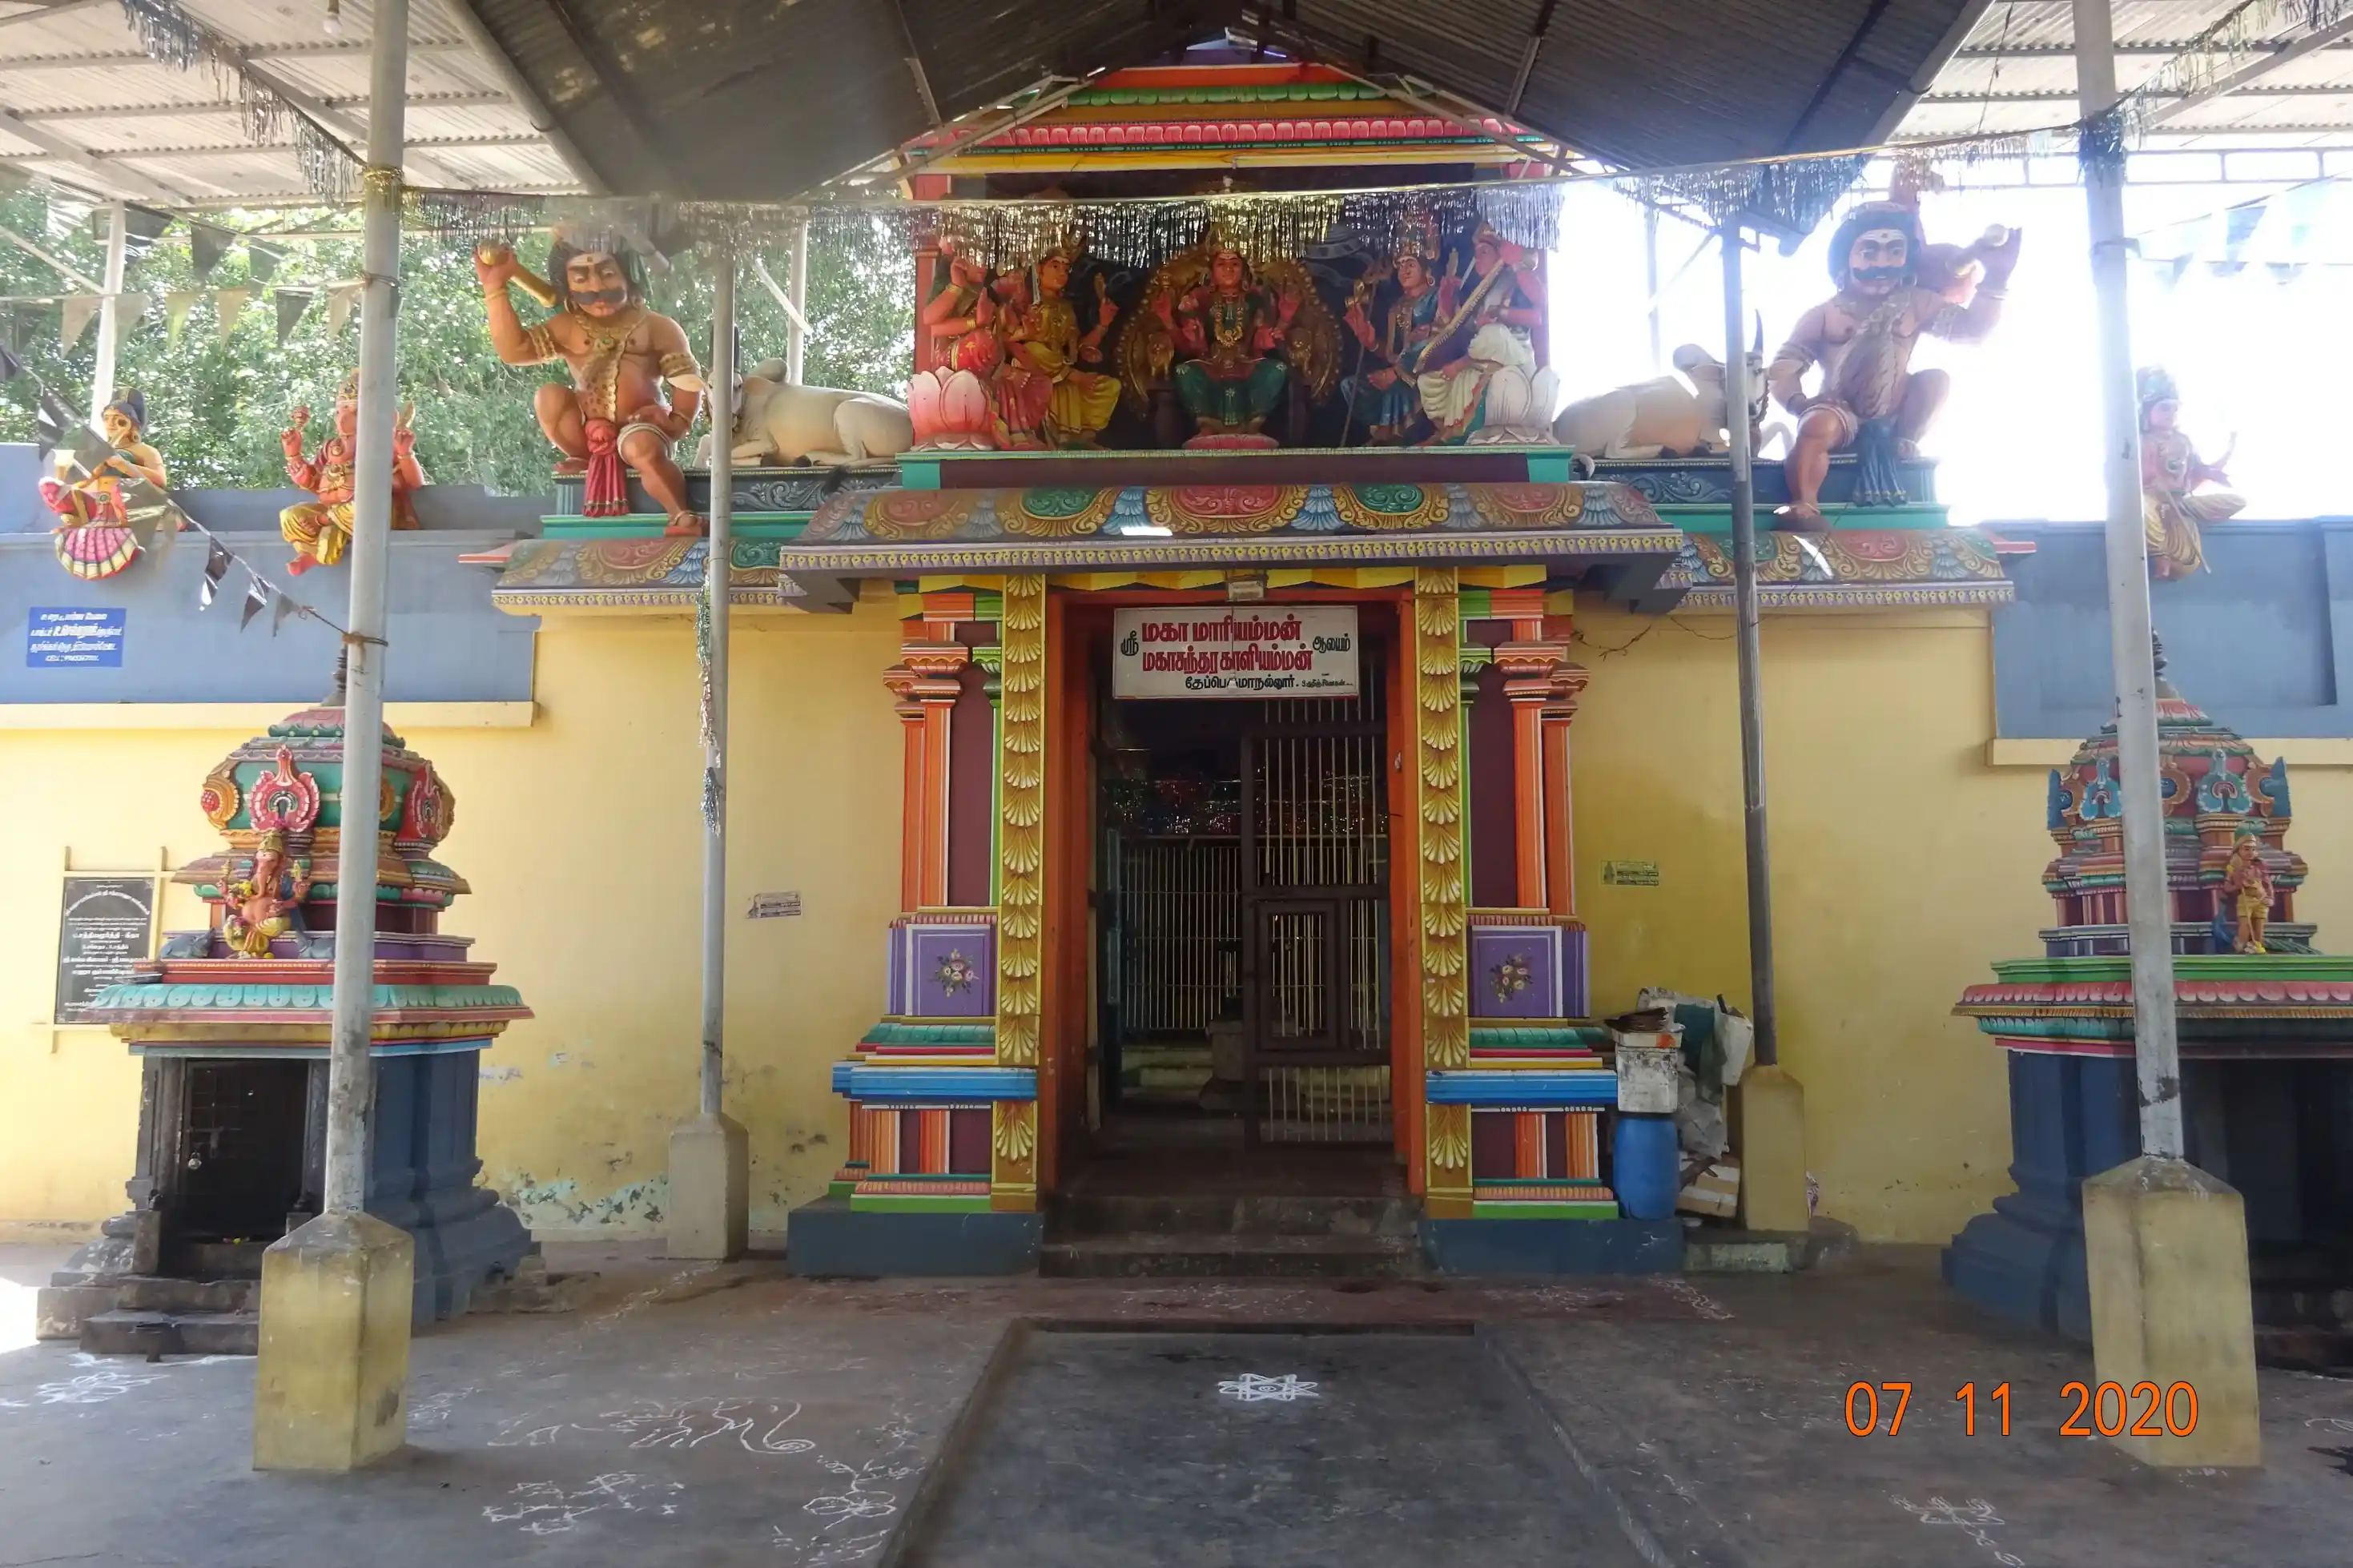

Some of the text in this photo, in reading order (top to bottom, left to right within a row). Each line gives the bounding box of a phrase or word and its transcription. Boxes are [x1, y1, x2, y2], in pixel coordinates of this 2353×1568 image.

[1141, 613, 1302, 641] மகா மாரியம்மன்
[1120, 630, 1139, 656] ஸ்ரீ
[1312, 633, 1351, 653] ஆலயம்
[1220, 643, 1313, 671] காளியம்மன்
